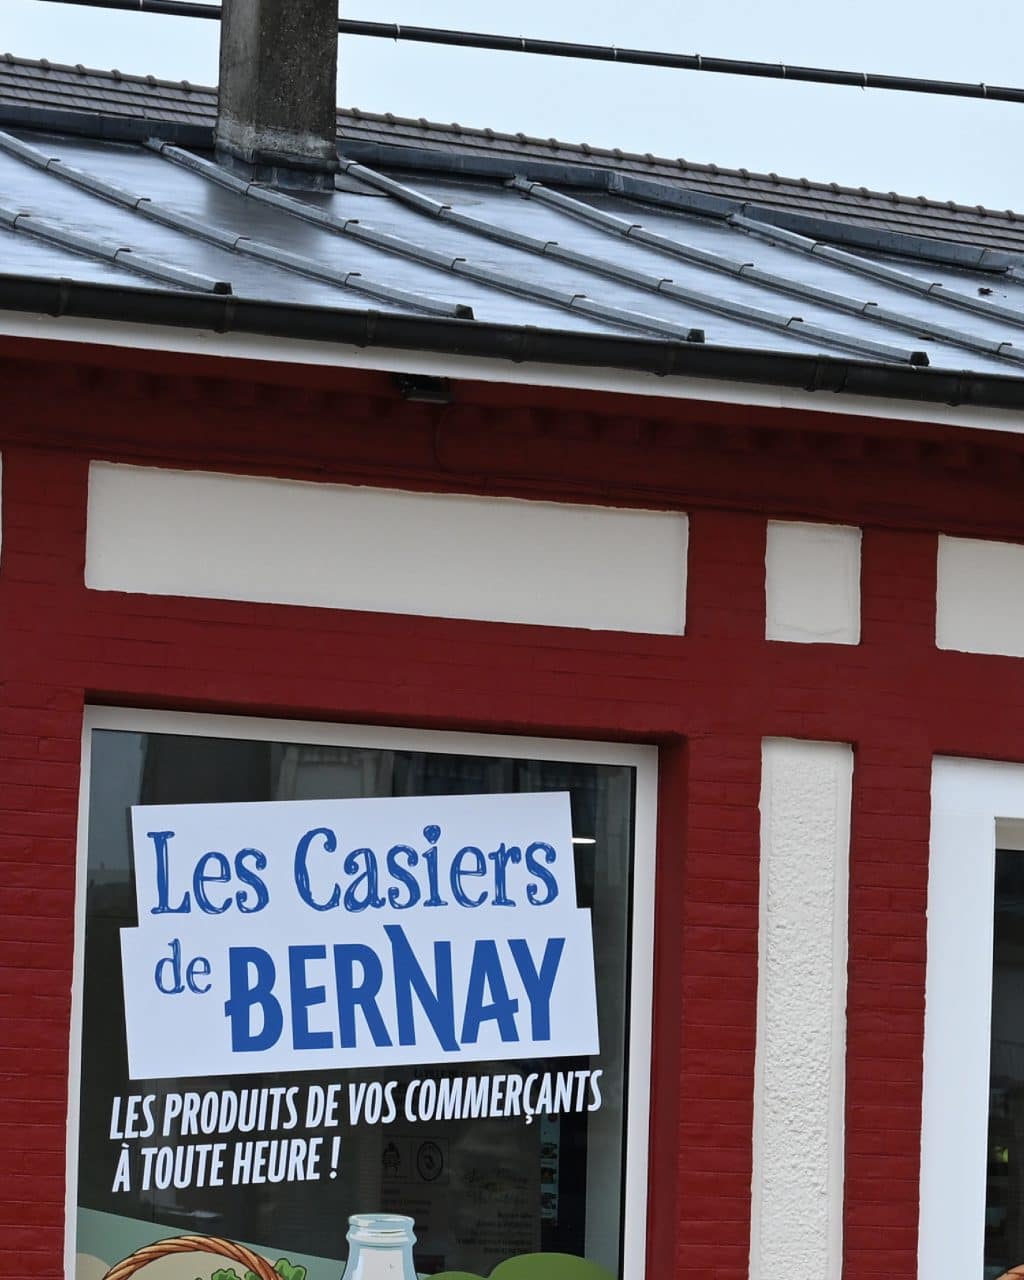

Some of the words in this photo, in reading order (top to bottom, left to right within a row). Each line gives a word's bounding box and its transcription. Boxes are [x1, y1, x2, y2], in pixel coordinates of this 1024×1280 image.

[147, 831, 269, 915] Les
[294, 825, 559, 913] Casiers
[155, 938, 211, 994] de
[224, 925, 565, 1052] BERNAY
[110, 1095, 155, 1139] LES
[163, 1087, 299, 1136] PRODUITS
[306, 1085, 341, 1127] DE
[349, 1081, 397, 1125] VOS
[405, 1070, 602, 1124] COMMERÇANTS
[112, 1143, 130, 1192] À
[141, 1144, 226, 1190] TOUTE
[232, 1138, 323, 1184] HEURE
